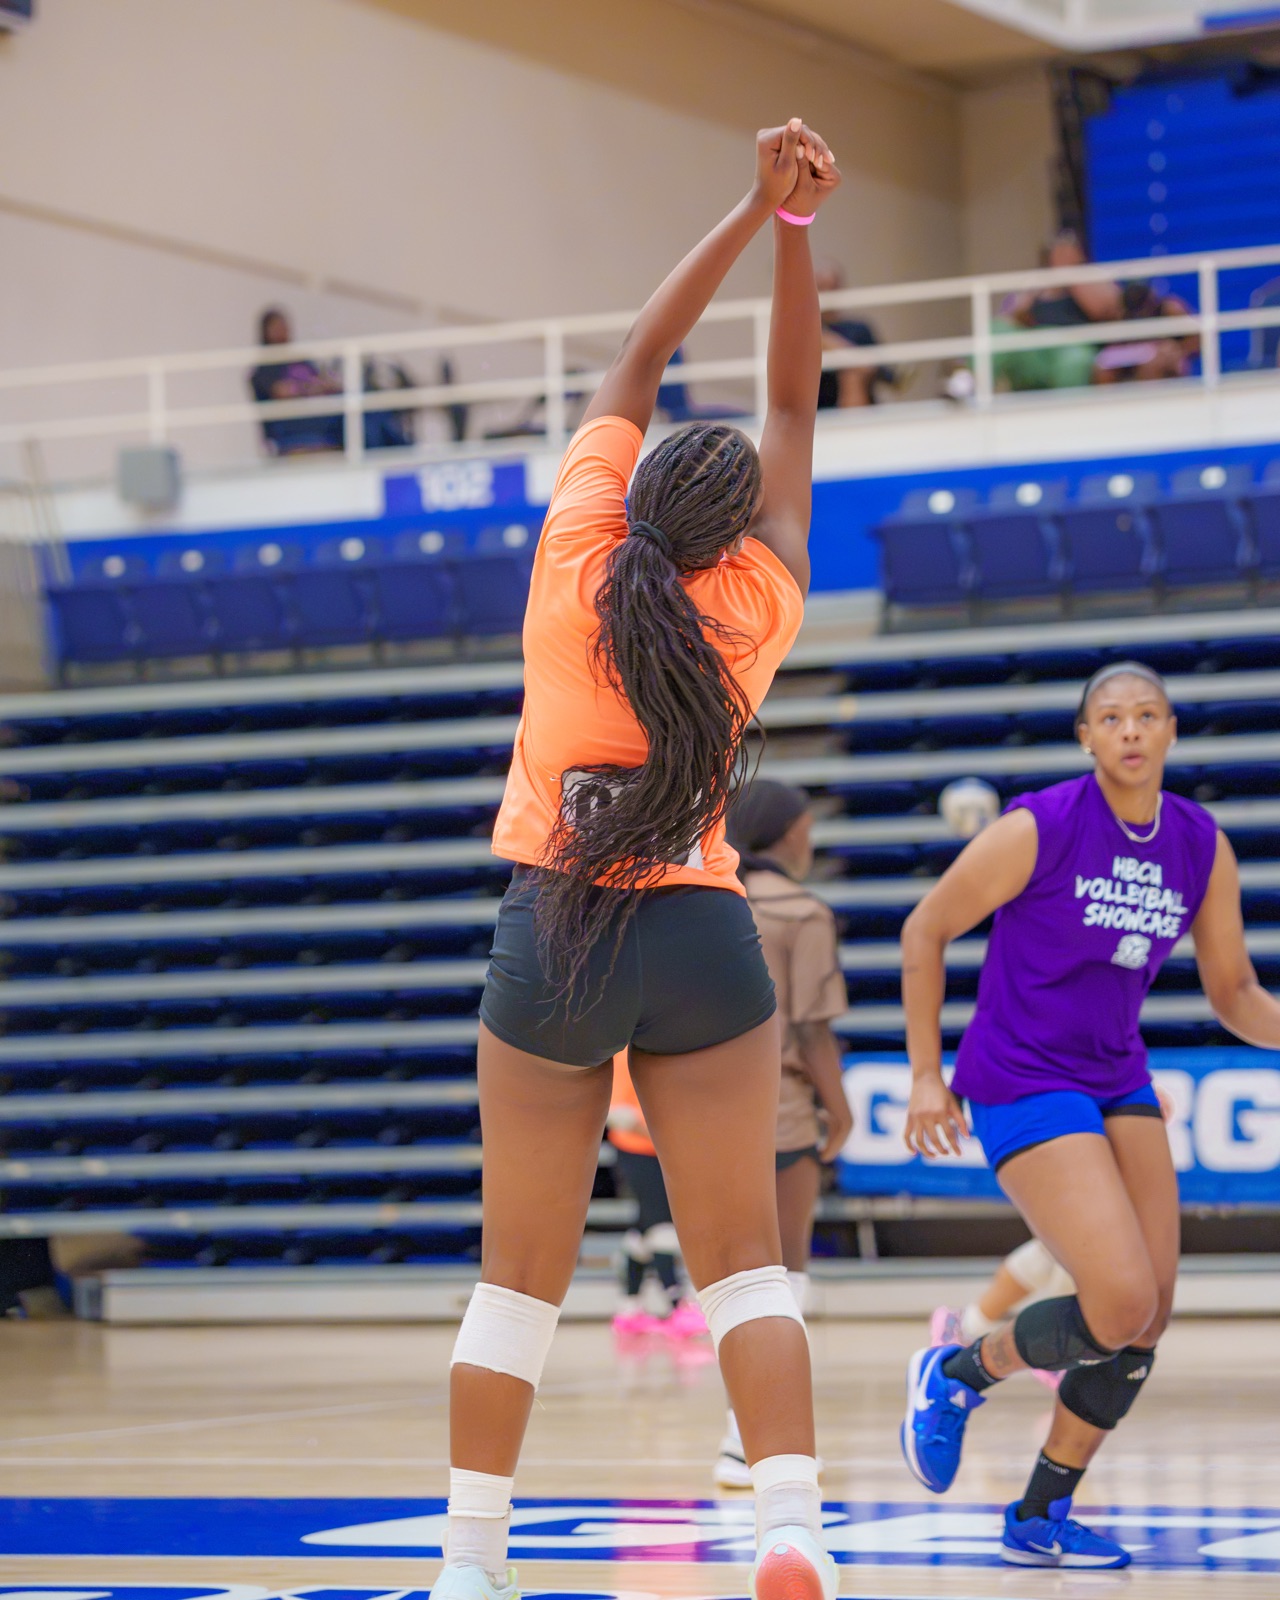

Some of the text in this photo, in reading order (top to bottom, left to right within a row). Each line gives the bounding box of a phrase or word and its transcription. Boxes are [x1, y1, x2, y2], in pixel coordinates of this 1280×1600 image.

[1112, 855, 1163, 887] HBCU
[1074, 874, 1188, 915] VOLLEYBALL
[1082, 902, 1182, 939] SHOWCASE
